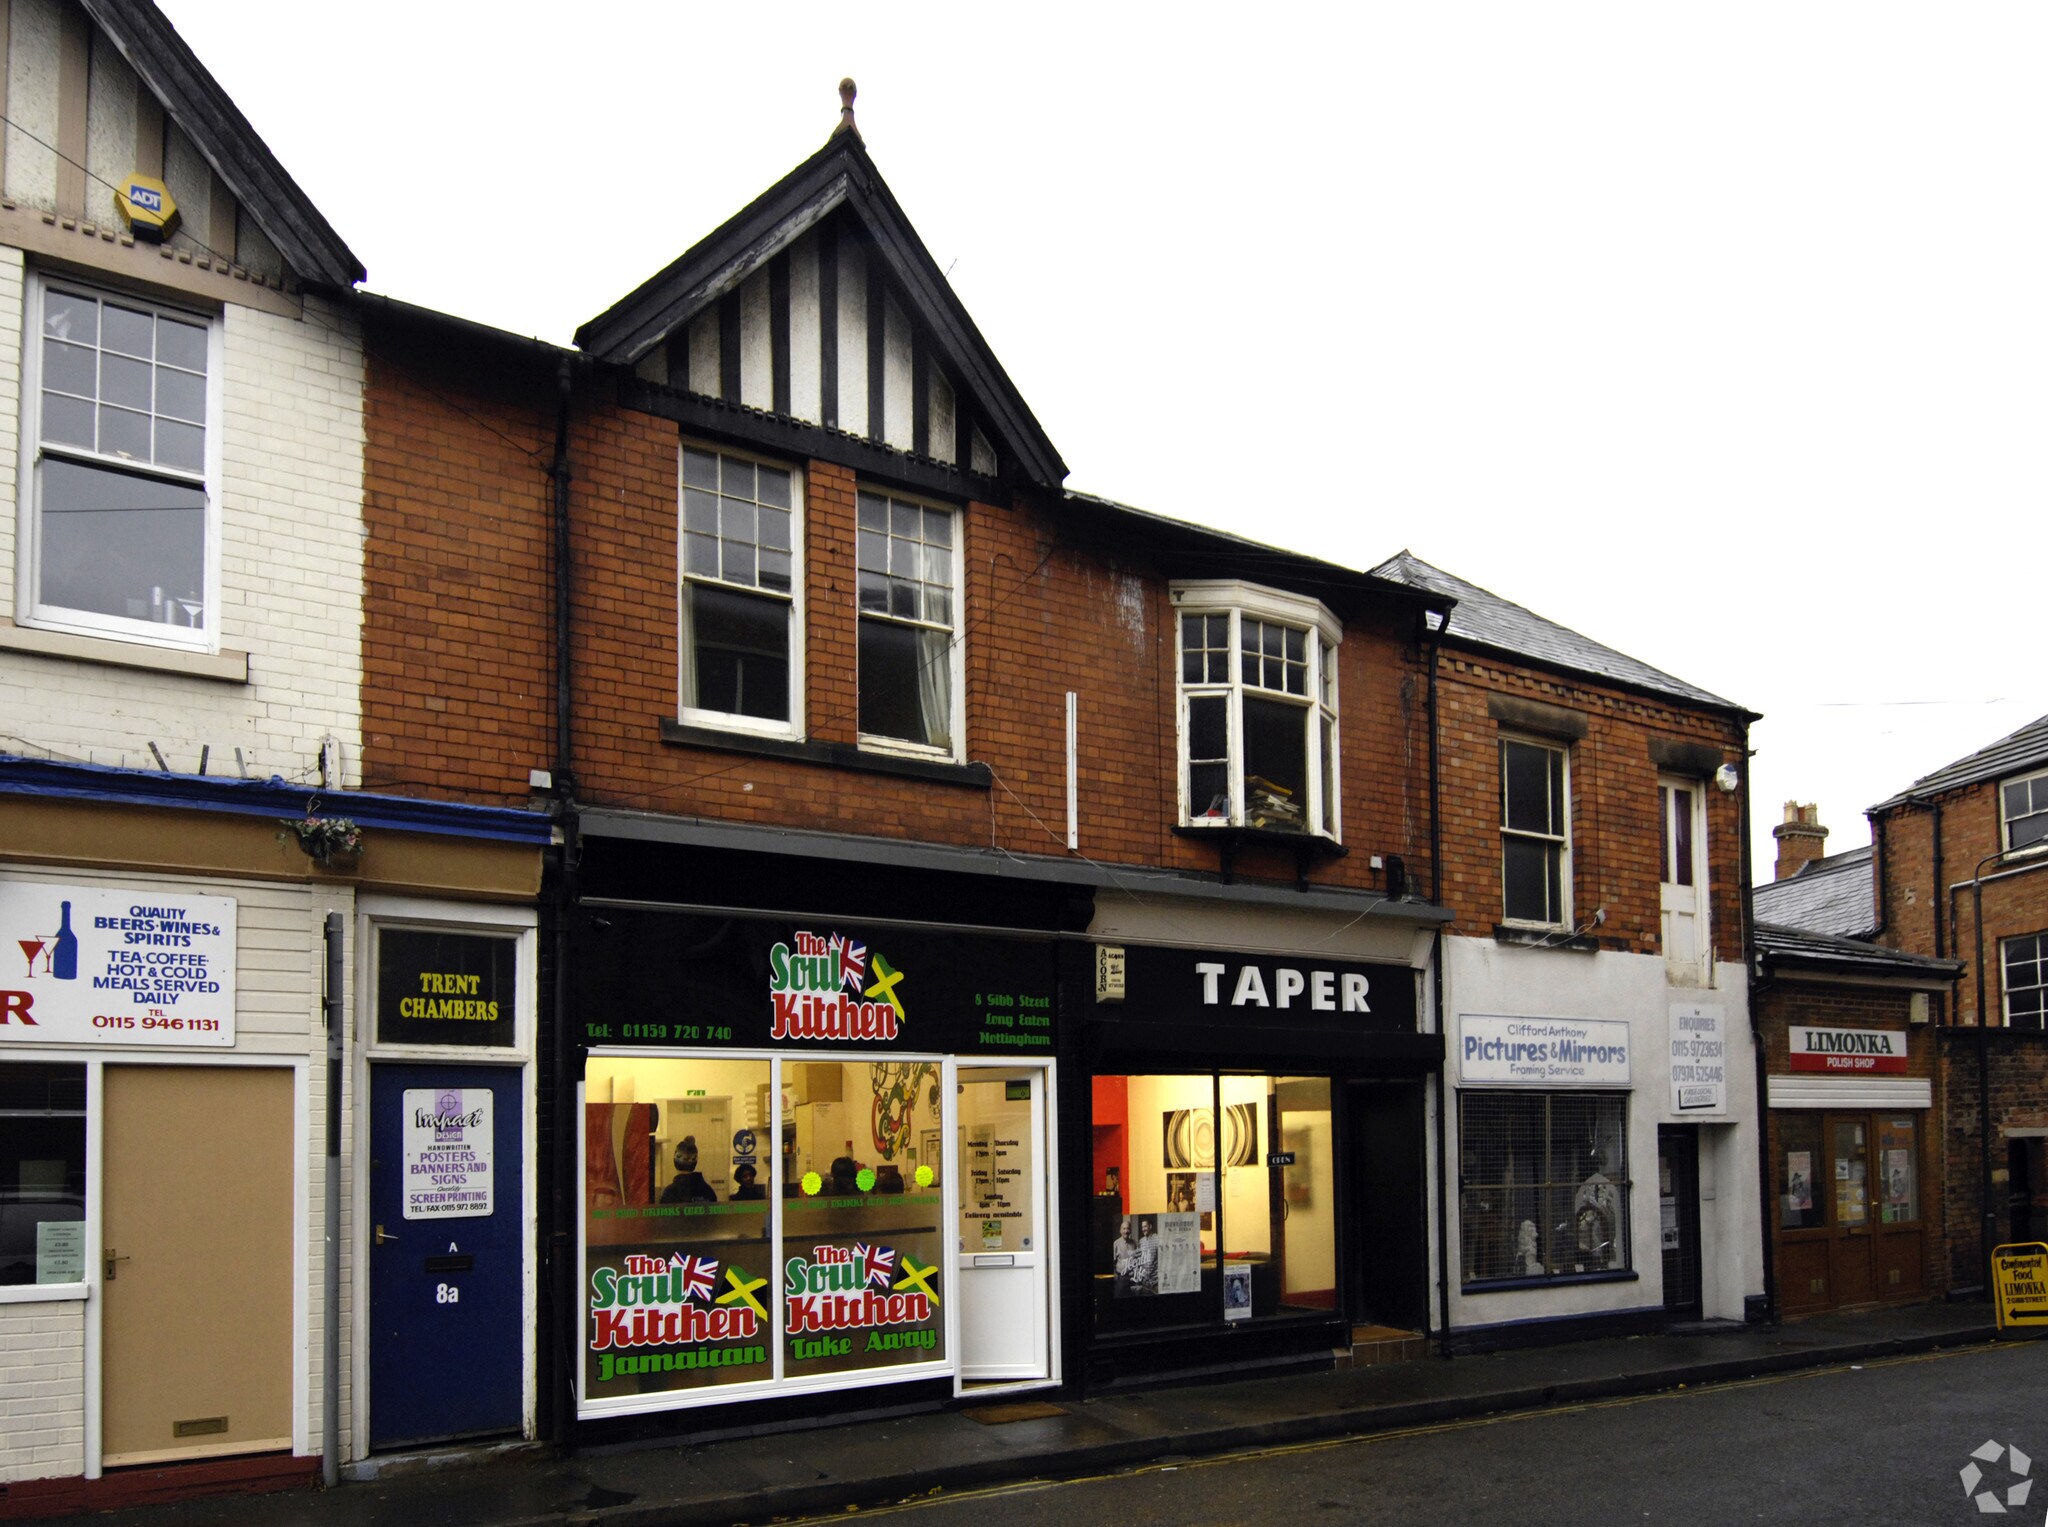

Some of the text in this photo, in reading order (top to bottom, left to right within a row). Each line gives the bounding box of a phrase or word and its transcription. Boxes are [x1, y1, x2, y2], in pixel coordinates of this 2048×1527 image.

[131, 190, 161, 207] ADT
[129, 905, 186, 920] QUALITY
[124, 931, 191, 947] SPIRITS
[794, 931, 826, 956] The
[107, 963, 207, 980] HOT & COLD
[770, 941, 842, 992] Soul
[93, 976, 220, 994] MEALS SERVED
[420, 972, 480, 995] TRENT
[1196, 962, 1371, 1013] TAPER
[133, 992, 180, 1005] DAILY
[1018, 994, 1050, 1008] Street
[400, 997, 499, 1021] CHAMBERS
[770, 991, 898, 1041] Kitchen
[92, 1015, 219, 1031] 0115 946 1131
[985, 1013, 1050, 1028] Long Eaton
[1679, 1016, 1716, 1032] ENQUIRIES
[585, 1023, 732, 1040] Tel: 01159 720 740
[979, 1031, 1051, 1047] Nottingham
[1507, 1024, 1588, 1038] Clifford Anthony
[1464, 1036, 1626, 1064] Pictures & Mirrors
[1672, 1040, 1689, 1057] 0115
[1805, 1031, 1893, 1054] LIMONKA
[1510, 1064, 1585, 1078] Framing Service
[1827, 1057, 1875, 1069] POLISH SHOP
[415, 1106, 484, 1132] Impact
[420, 1151, 476, 1163] POSTERS
[410, 1162, 487, 1175] BANNERS AND
[431, 1174, 467, 1186] SIGNS
[410, 1191, 487, 1204] SCREEN PRINTING
[449, 1242, 458, 1252] A
[814, 1245, 849, 1265] The
[624, 1254, 667, 1276] The
[785, 1254, 869, 1296] Soul
[2012, 1268, 2033, 1282] Food
[436, 1283, 459, 1304] 8a
[591, 1265, 688, 1309] Soul
[2005, 1281, 2047, 1296] LIMONKA
[786, 1288, 931, 1335] Kitchen
[590, 1303, 758, 1351] Kitchen
[790, 1329, 937, 1360] Take Away
[597, 1345, 768, 1382] Jamaican
